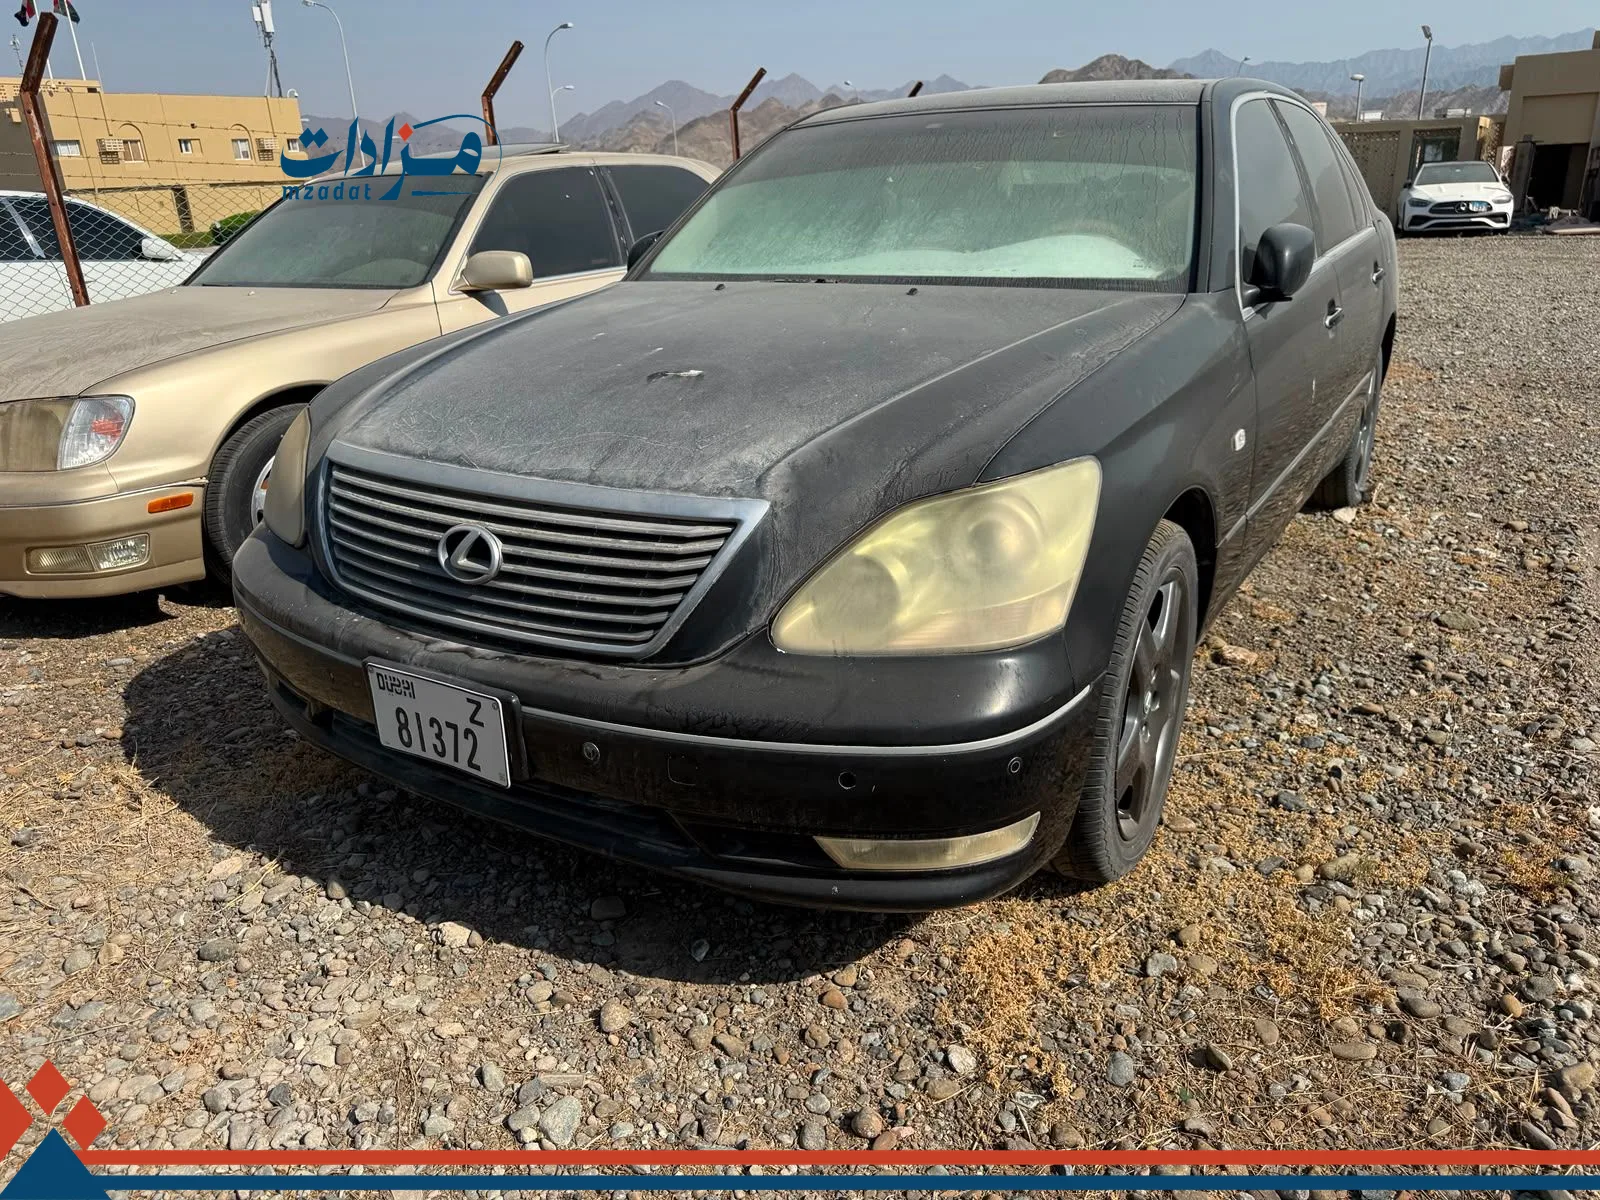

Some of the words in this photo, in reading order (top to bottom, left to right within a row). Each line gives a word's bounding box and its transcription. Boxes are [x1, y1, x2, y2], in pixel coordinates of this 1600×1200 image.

[376, 671, 416, 699] DUBAI
[466, 697, 485, 728] Z
[395, 706, 482, 772] 81372
